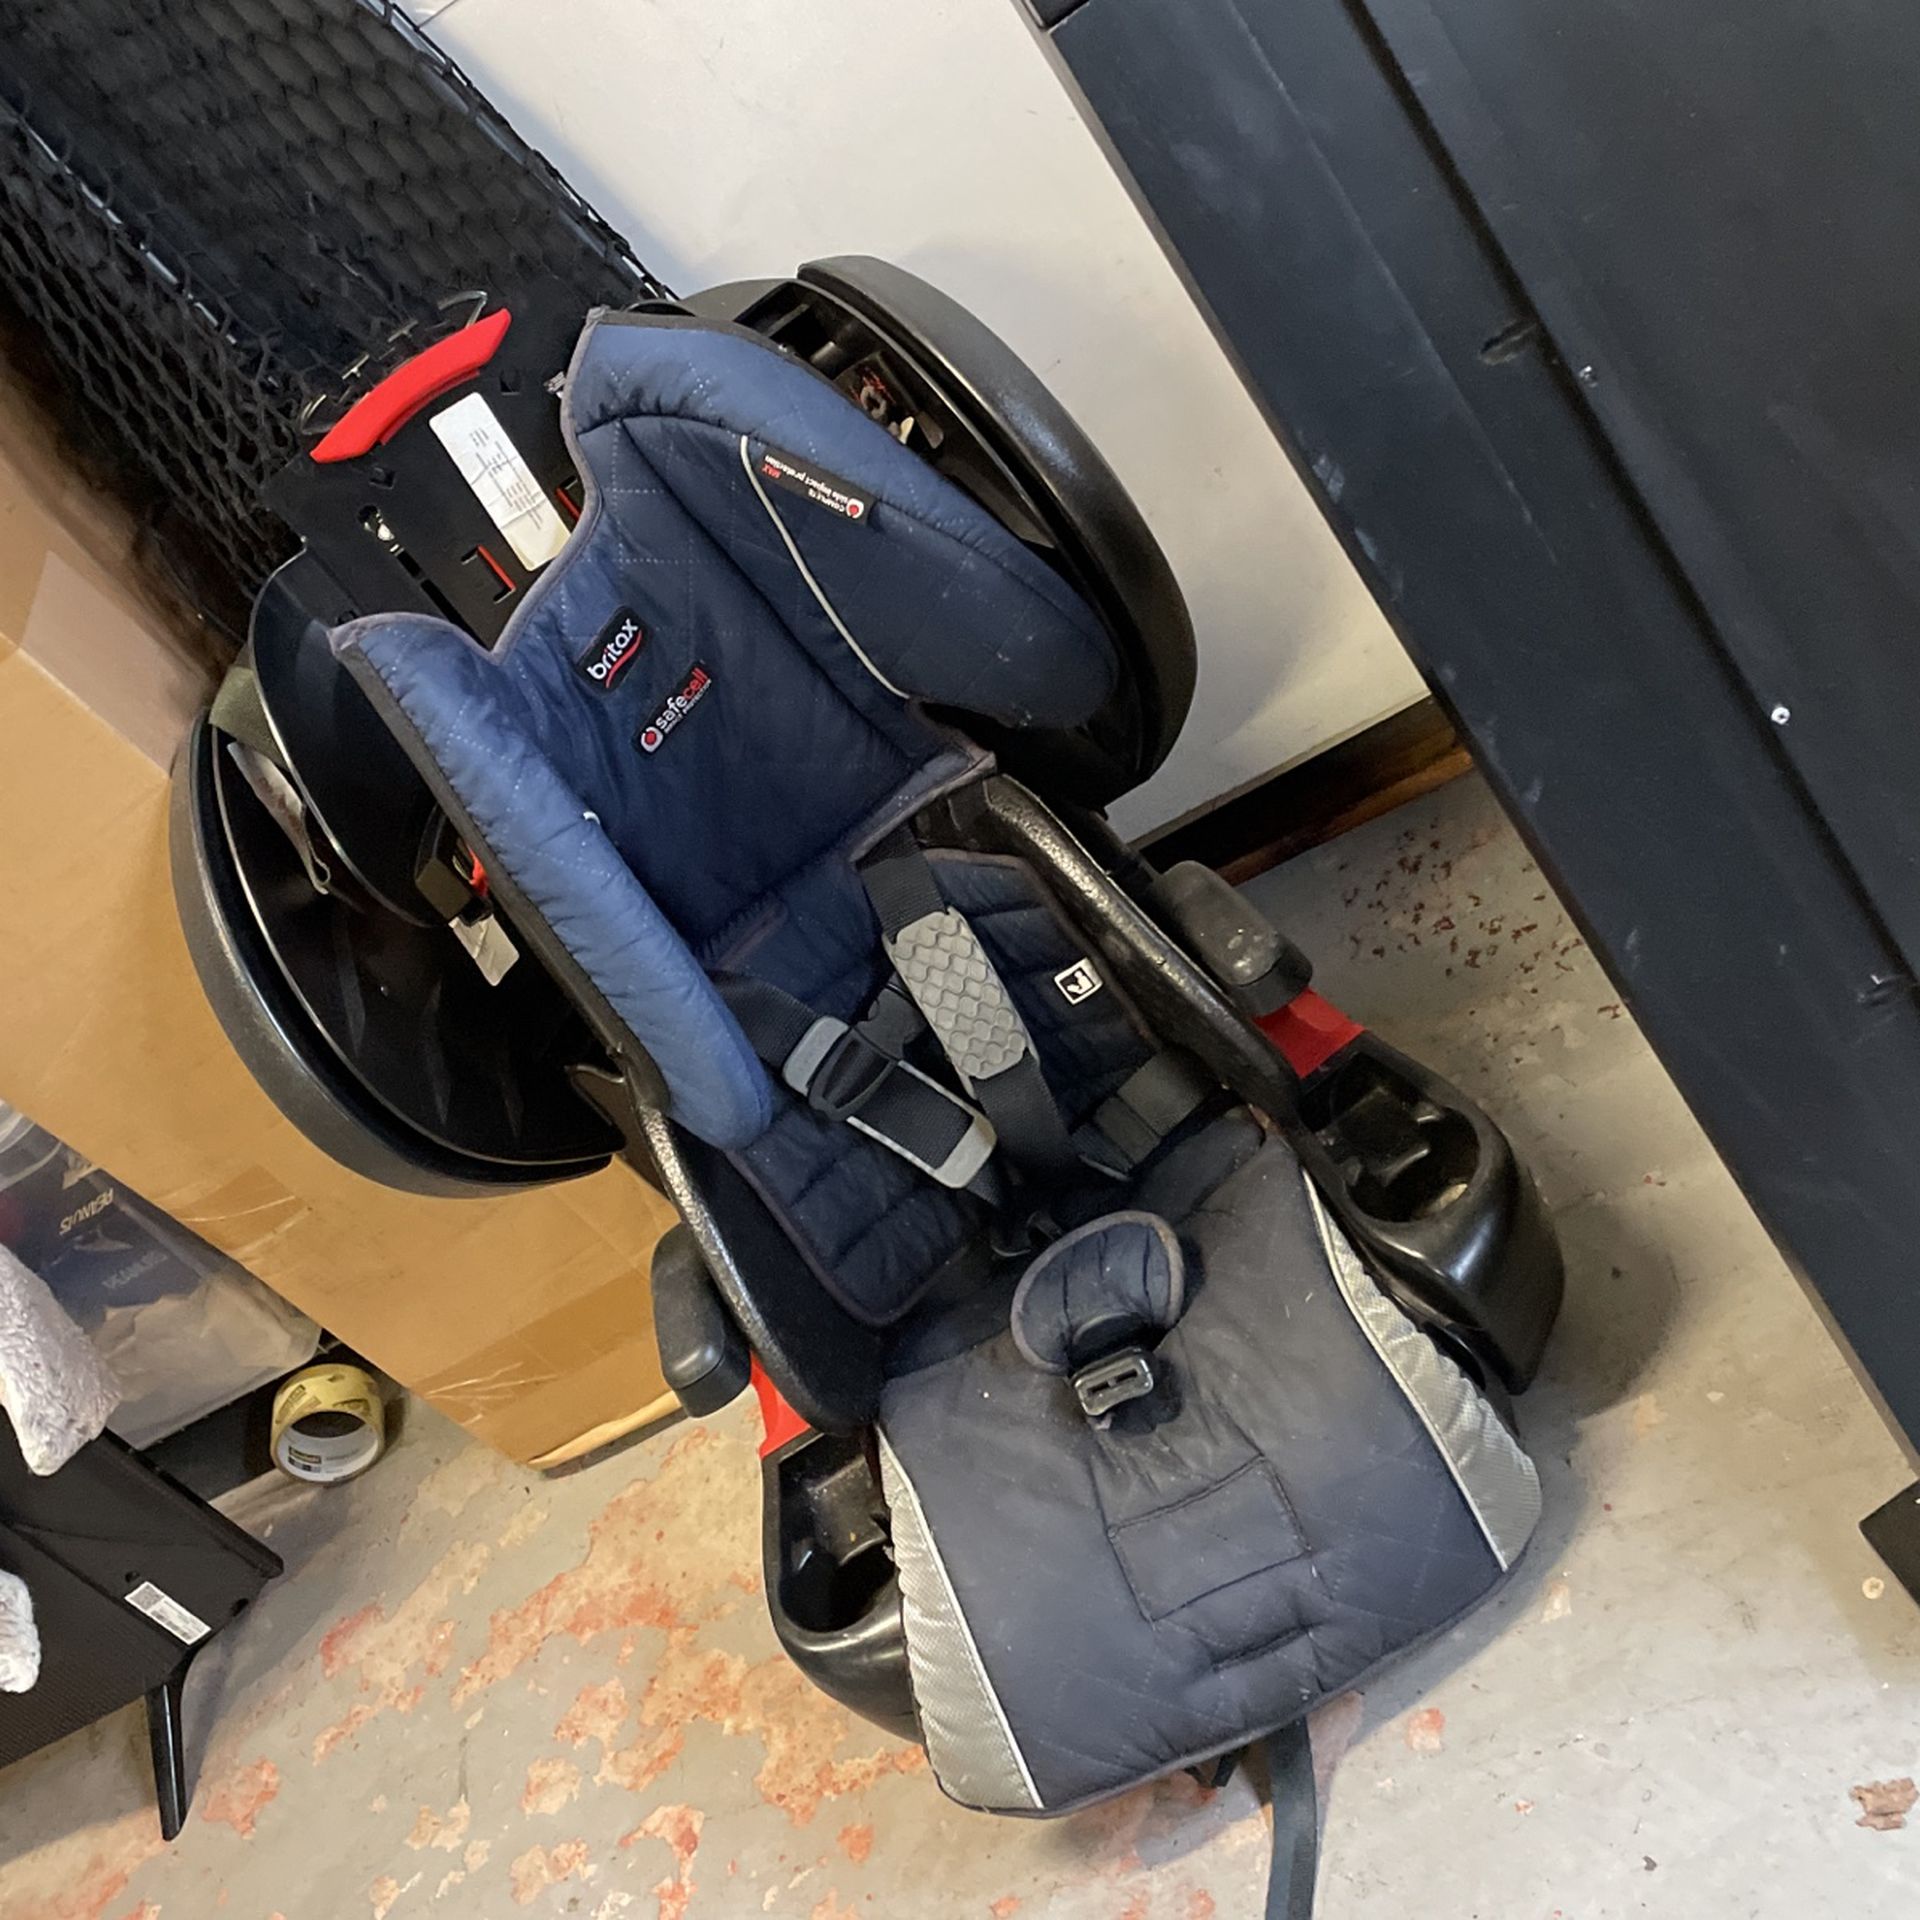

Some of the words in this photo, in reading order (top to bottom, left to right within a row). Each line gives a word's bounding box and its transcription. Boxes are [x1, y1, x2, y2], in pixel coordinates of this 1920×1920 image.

[764, 454, 807, 481] protection
[805, 476, 832, 497] impact
[586, 618, 639, 680] britax
[655, 667, 708, 729] safecell
